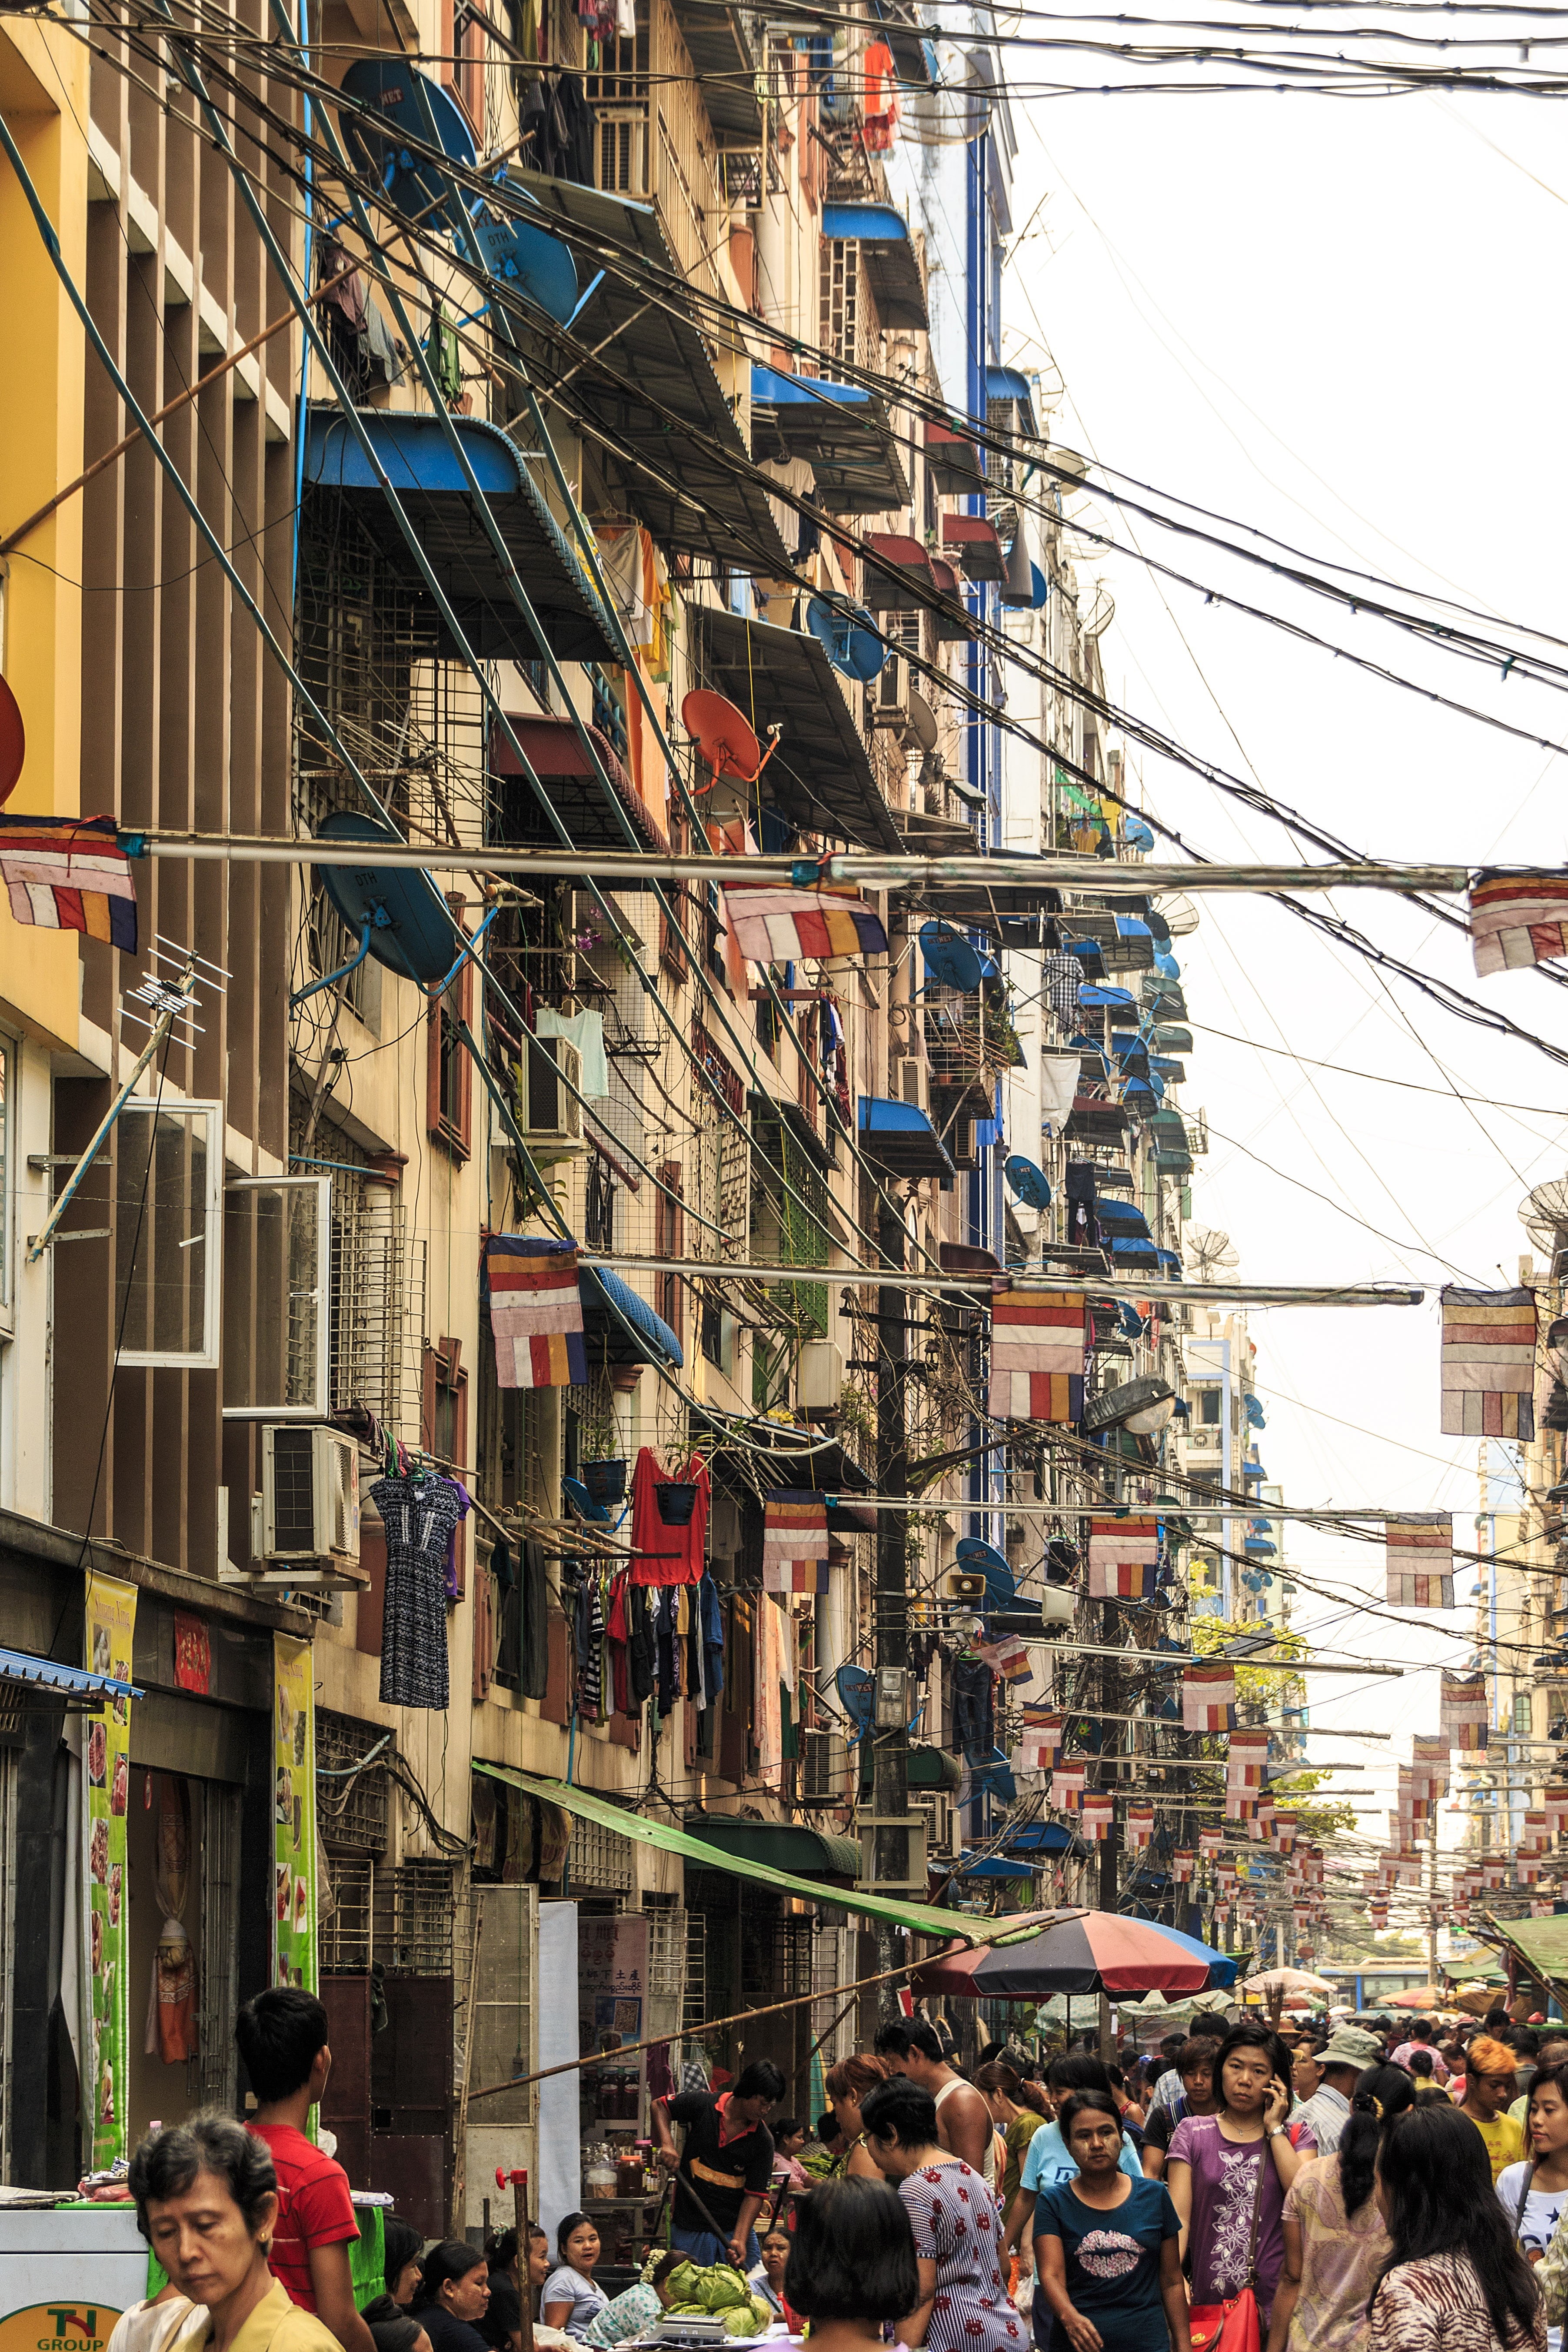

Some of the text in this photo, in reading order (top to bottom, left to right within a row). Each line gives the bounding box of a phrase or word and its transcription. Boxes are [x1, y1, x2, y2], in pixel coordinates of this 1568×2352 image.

[487, 231, 509, 246] DTH
[355, 872, 378, 887] DTH
[37, 2339, 104, 2352] GROUP
